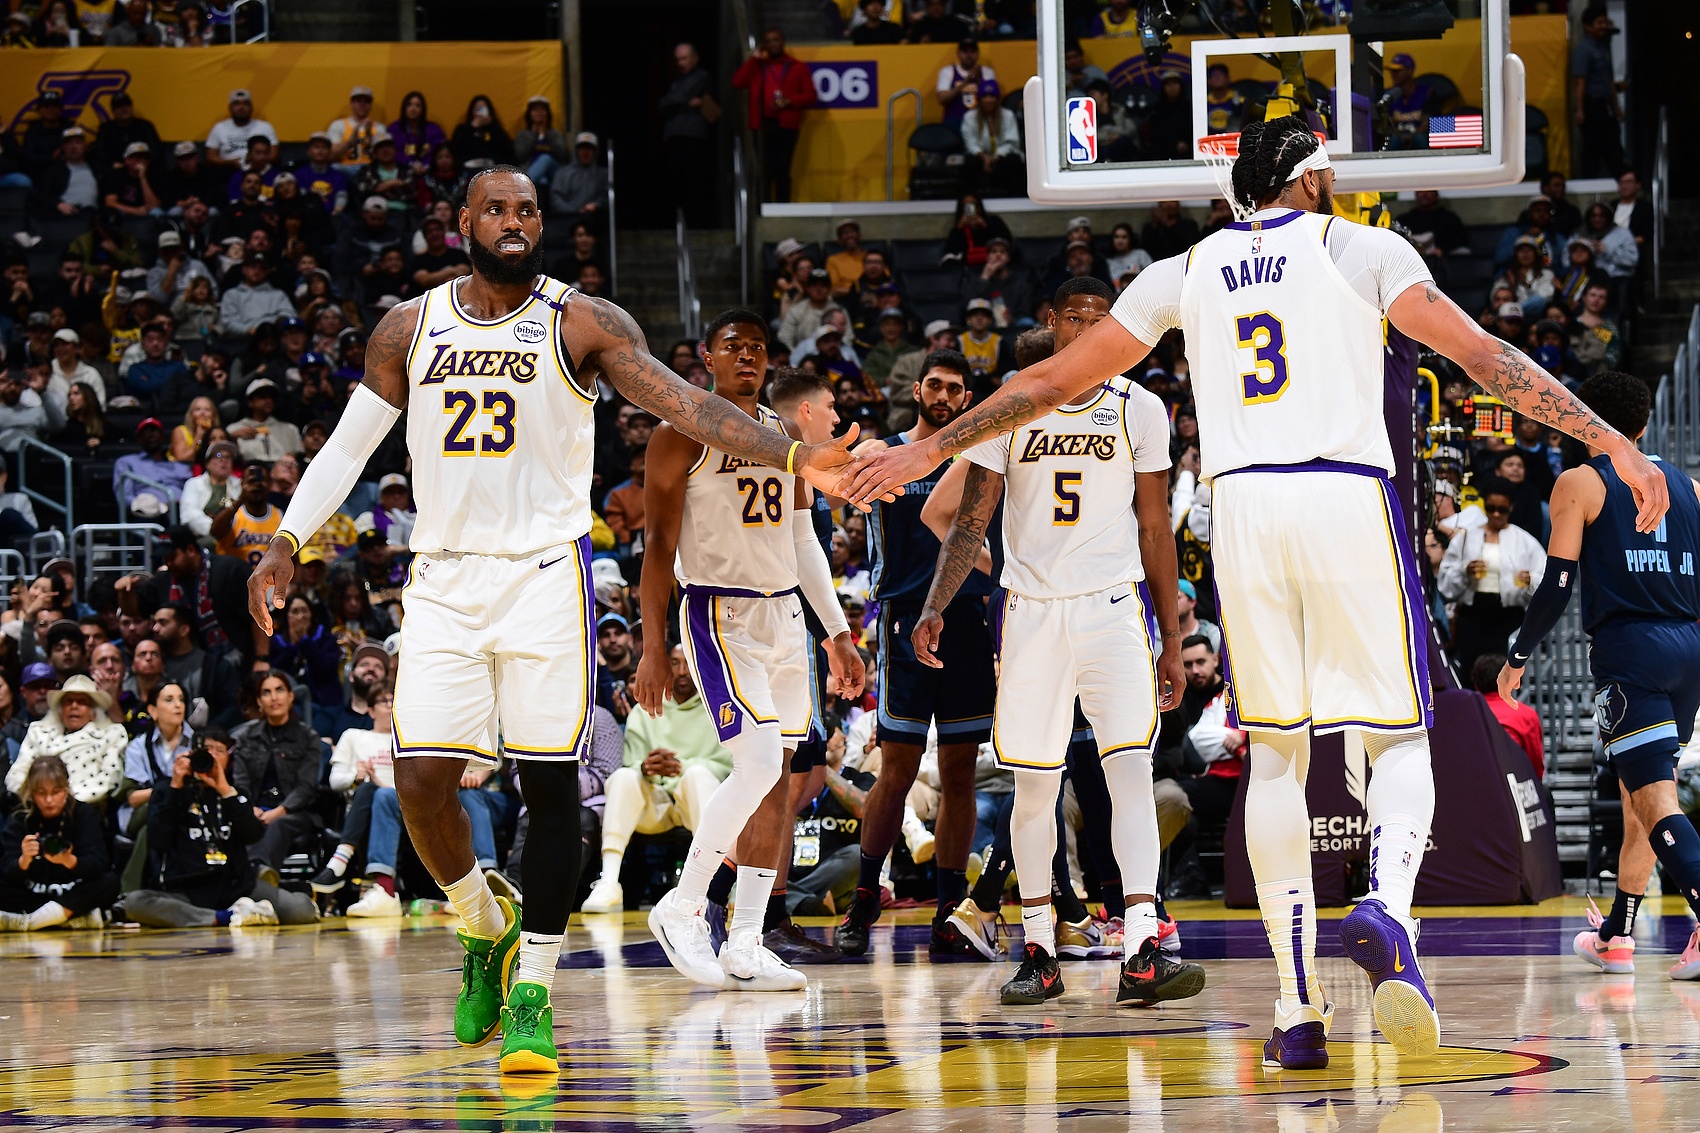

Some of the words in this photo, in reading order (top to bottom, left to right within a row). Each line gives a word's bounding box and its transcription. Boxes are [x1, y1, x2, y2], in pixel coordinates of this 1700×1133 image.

[1221, 255, 1286, 292] DAVIS
[517, 325, 545, 338] bibigo
[418, 343, 540, 387] LAKERS
[1234, 310, 1291, 406] 3
[442, 389, 518, 458] 23
[1093, 412, 1117, 422] bibigo
[1018, 428, 1117, 463] LAKERS
[736, 476, 784, 528] 28
[1052, 470, 1083, 526] 5
[1310, 837, 1363, 852] ESORT
